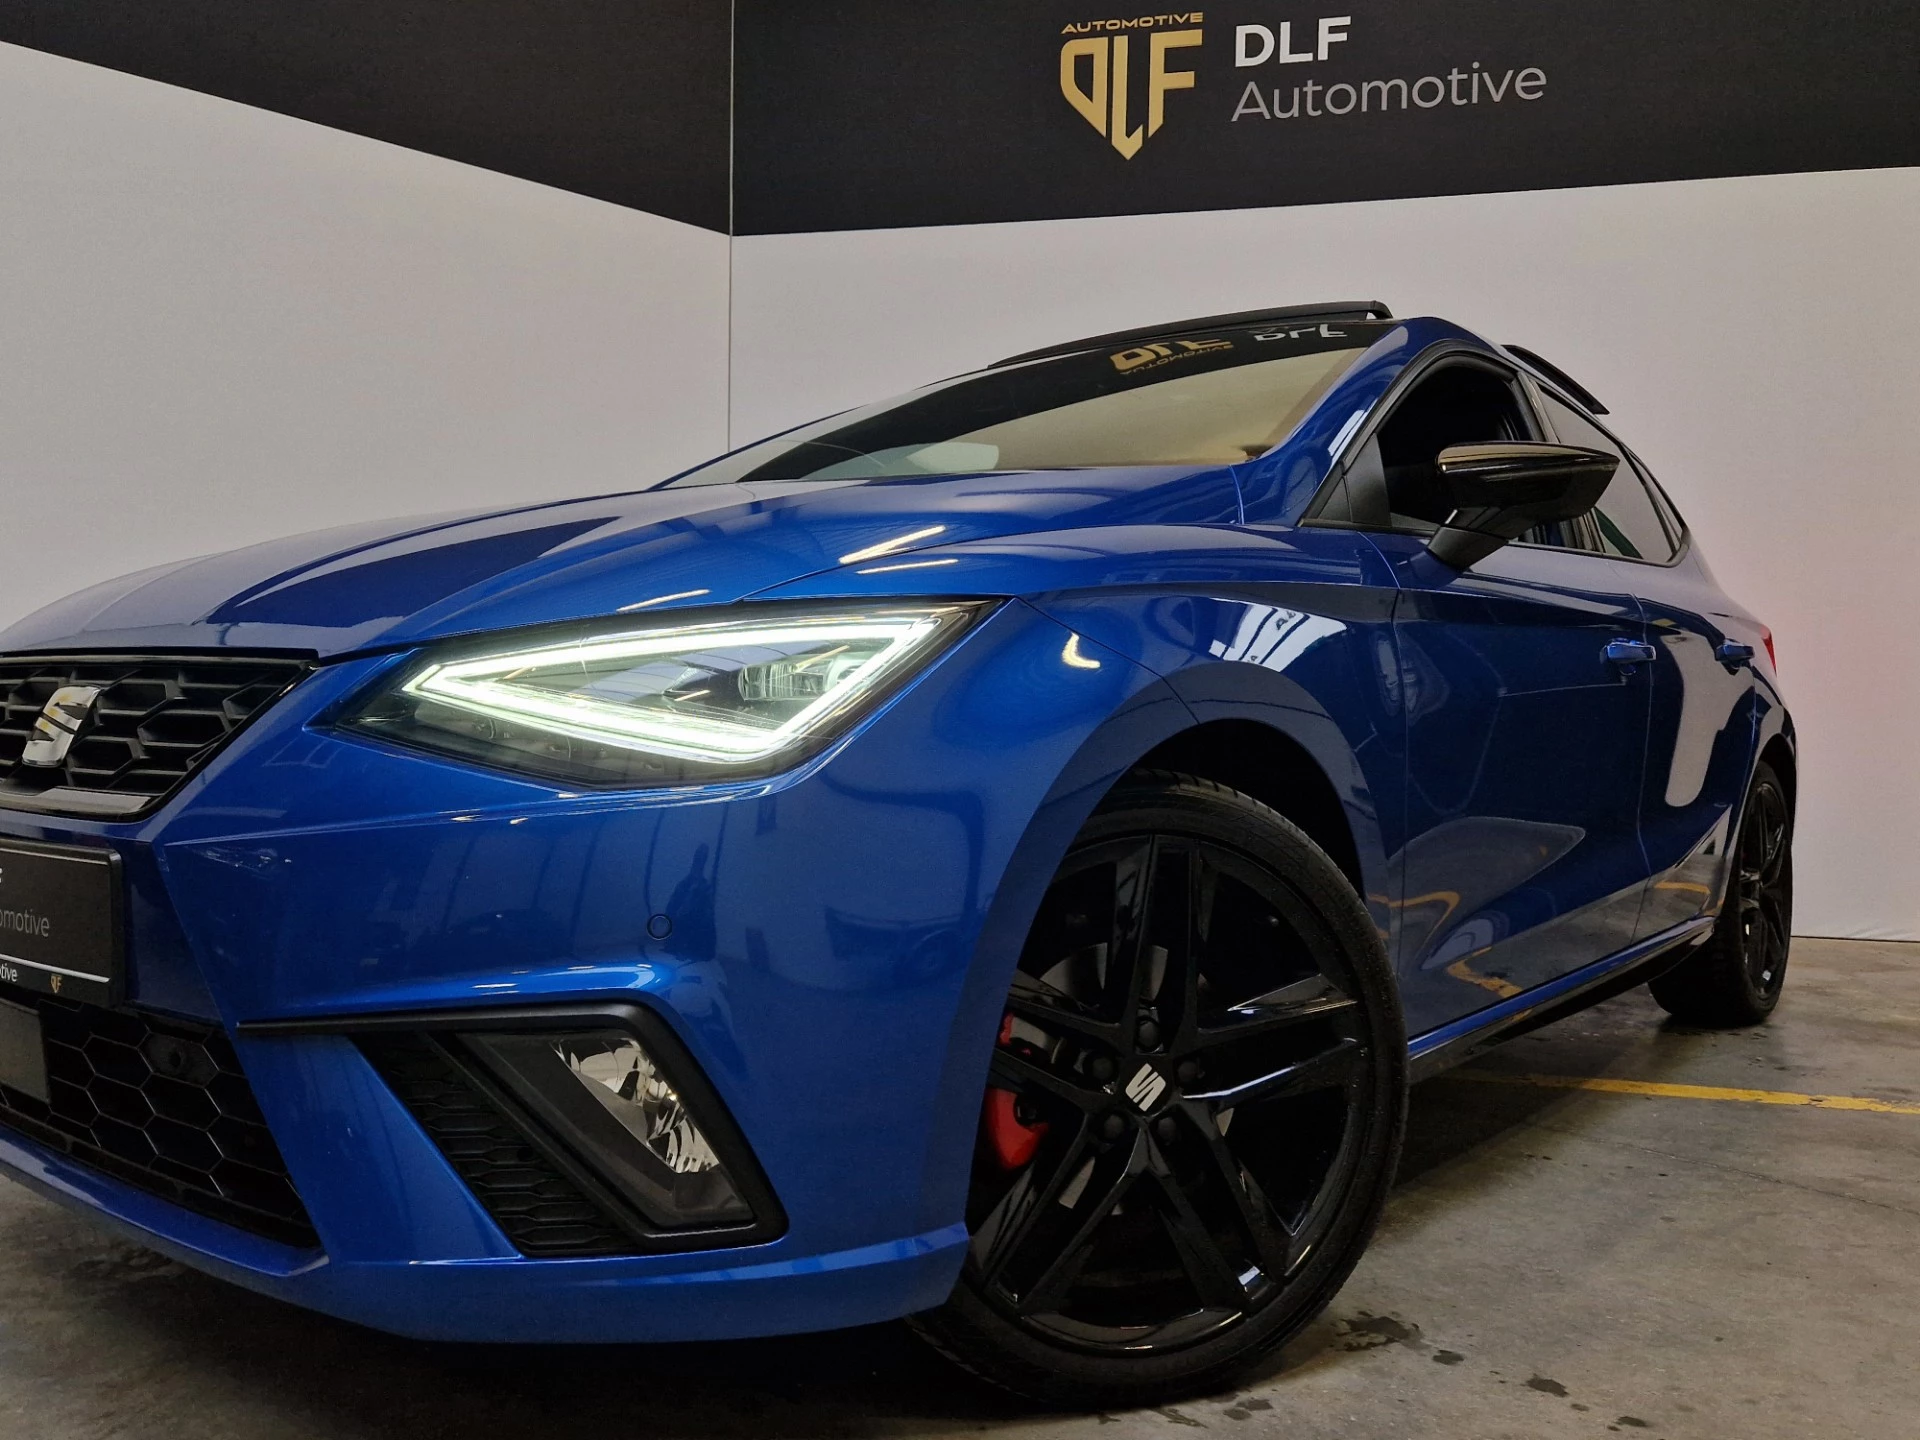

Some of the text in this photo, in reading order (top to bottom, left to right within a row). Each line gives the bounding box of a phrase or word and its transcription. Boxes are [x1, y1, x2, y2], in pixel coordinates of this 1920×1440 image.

[1061, 12, 1204, 35] AUTOMOTIVE
[1235, 15, 1352, 68] DLF
[1060, 29, 1203, 161] DLF
[1231, 61, 1548, 122] Automotive
